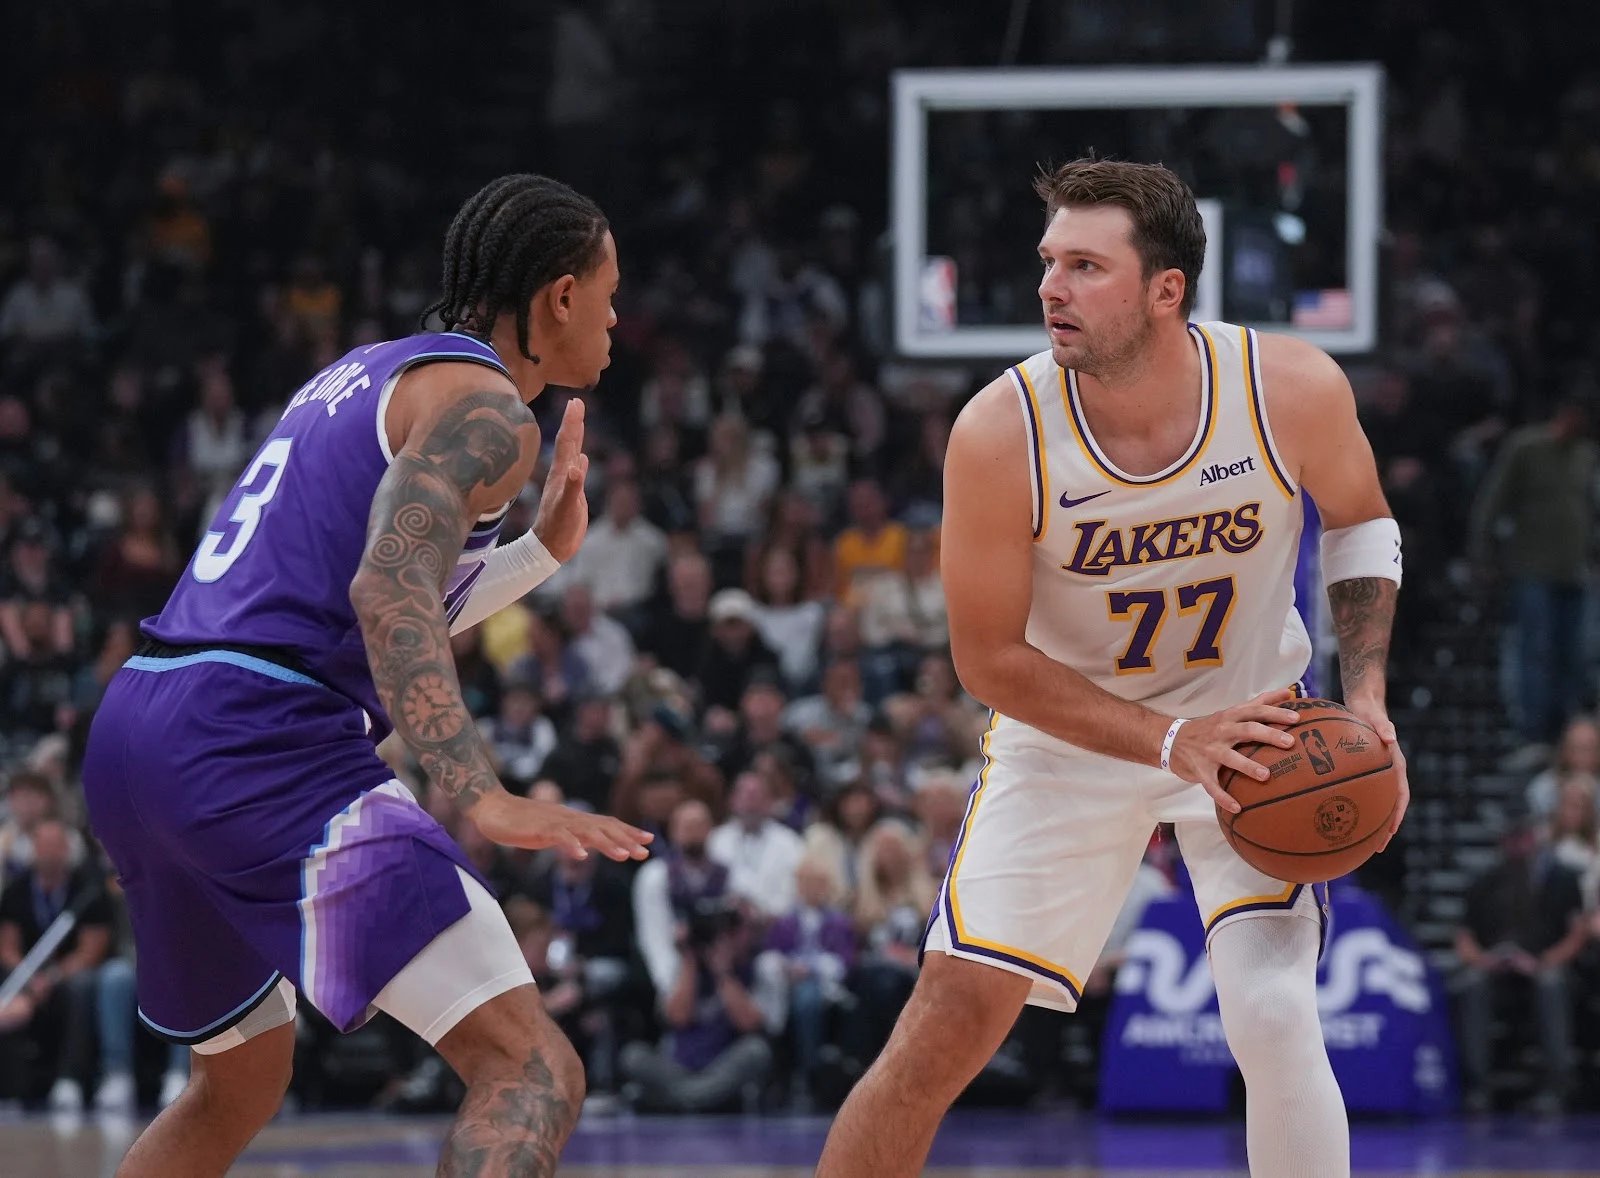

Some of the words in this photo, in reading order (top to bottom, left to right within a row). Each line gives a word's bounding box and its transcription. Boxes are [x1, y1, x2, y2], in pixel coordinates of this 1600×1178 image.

[192, 438, 293, 584] 3
[1199, 456, 1257, 487] Albert
[1060, 501, 1264, 576] LAKERS
[1105, 574, 1238, 677] 77
